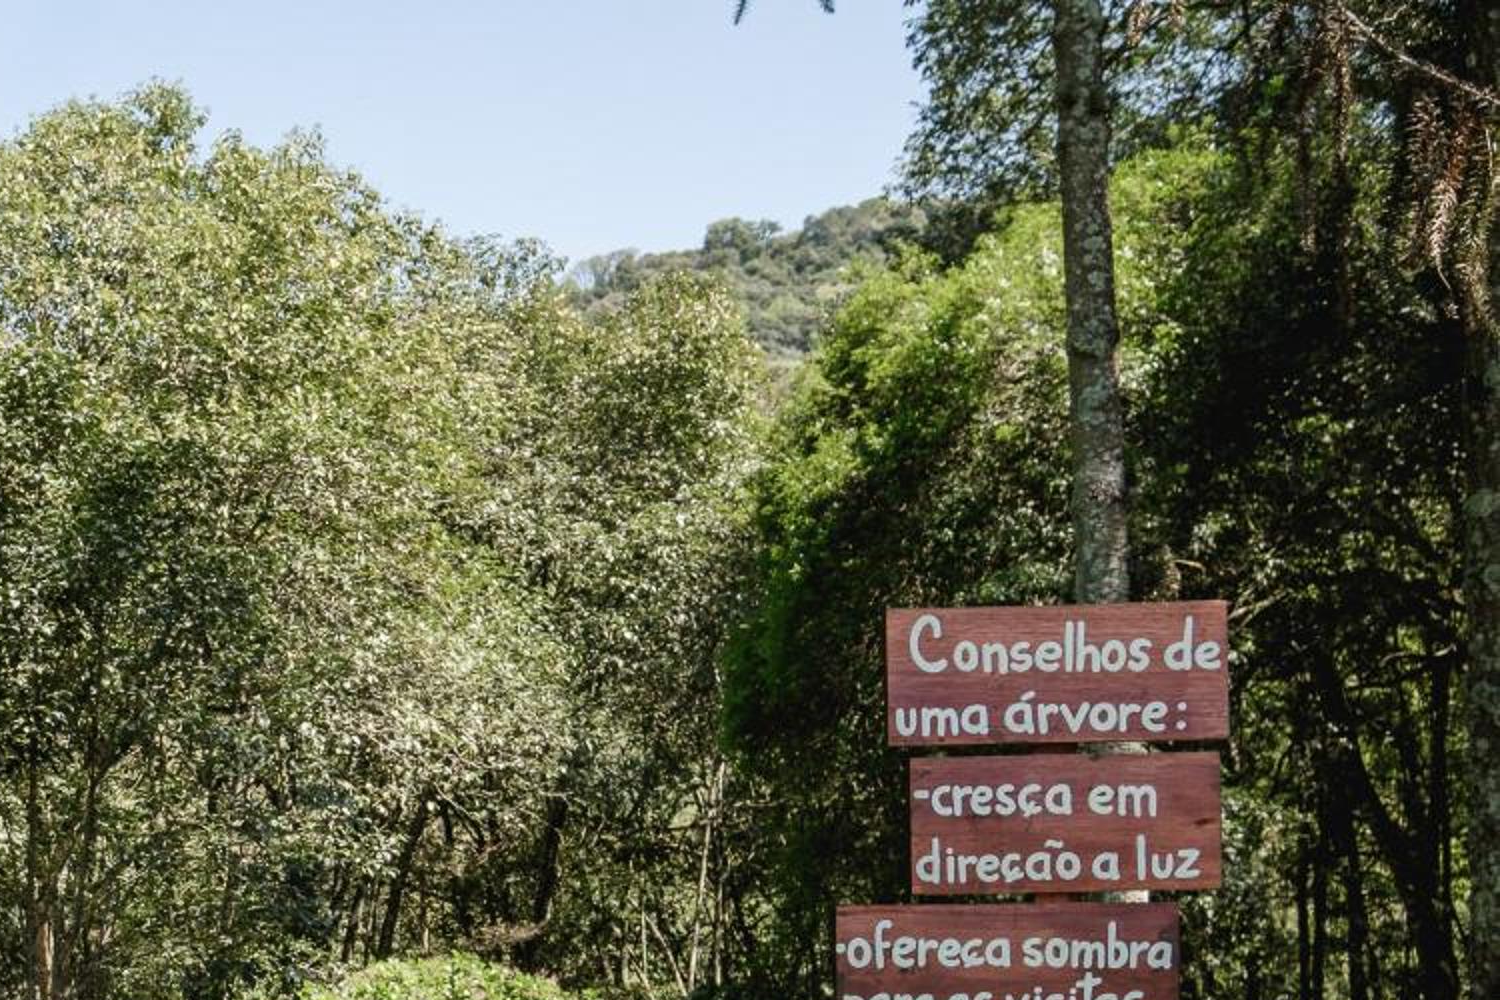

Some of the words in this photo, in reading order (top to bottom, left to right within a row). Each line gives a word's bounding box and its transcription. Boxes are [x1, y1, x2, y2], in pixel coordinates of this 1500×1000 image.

[908, 614, 1153, 674] Conselhos
[1163, 615, 1222, 672] de
[894, 702, 989, 737] uma
[1003, 690, 1188, 735] árvore:
[913, 782, 1072, 818] -cresça
[1087, 784, 1158, 818] em
[1090, 850, 1120, 882] a
[1135, 833, 1201, 882] luz
[1021, 920, 1173, 970] sombra
